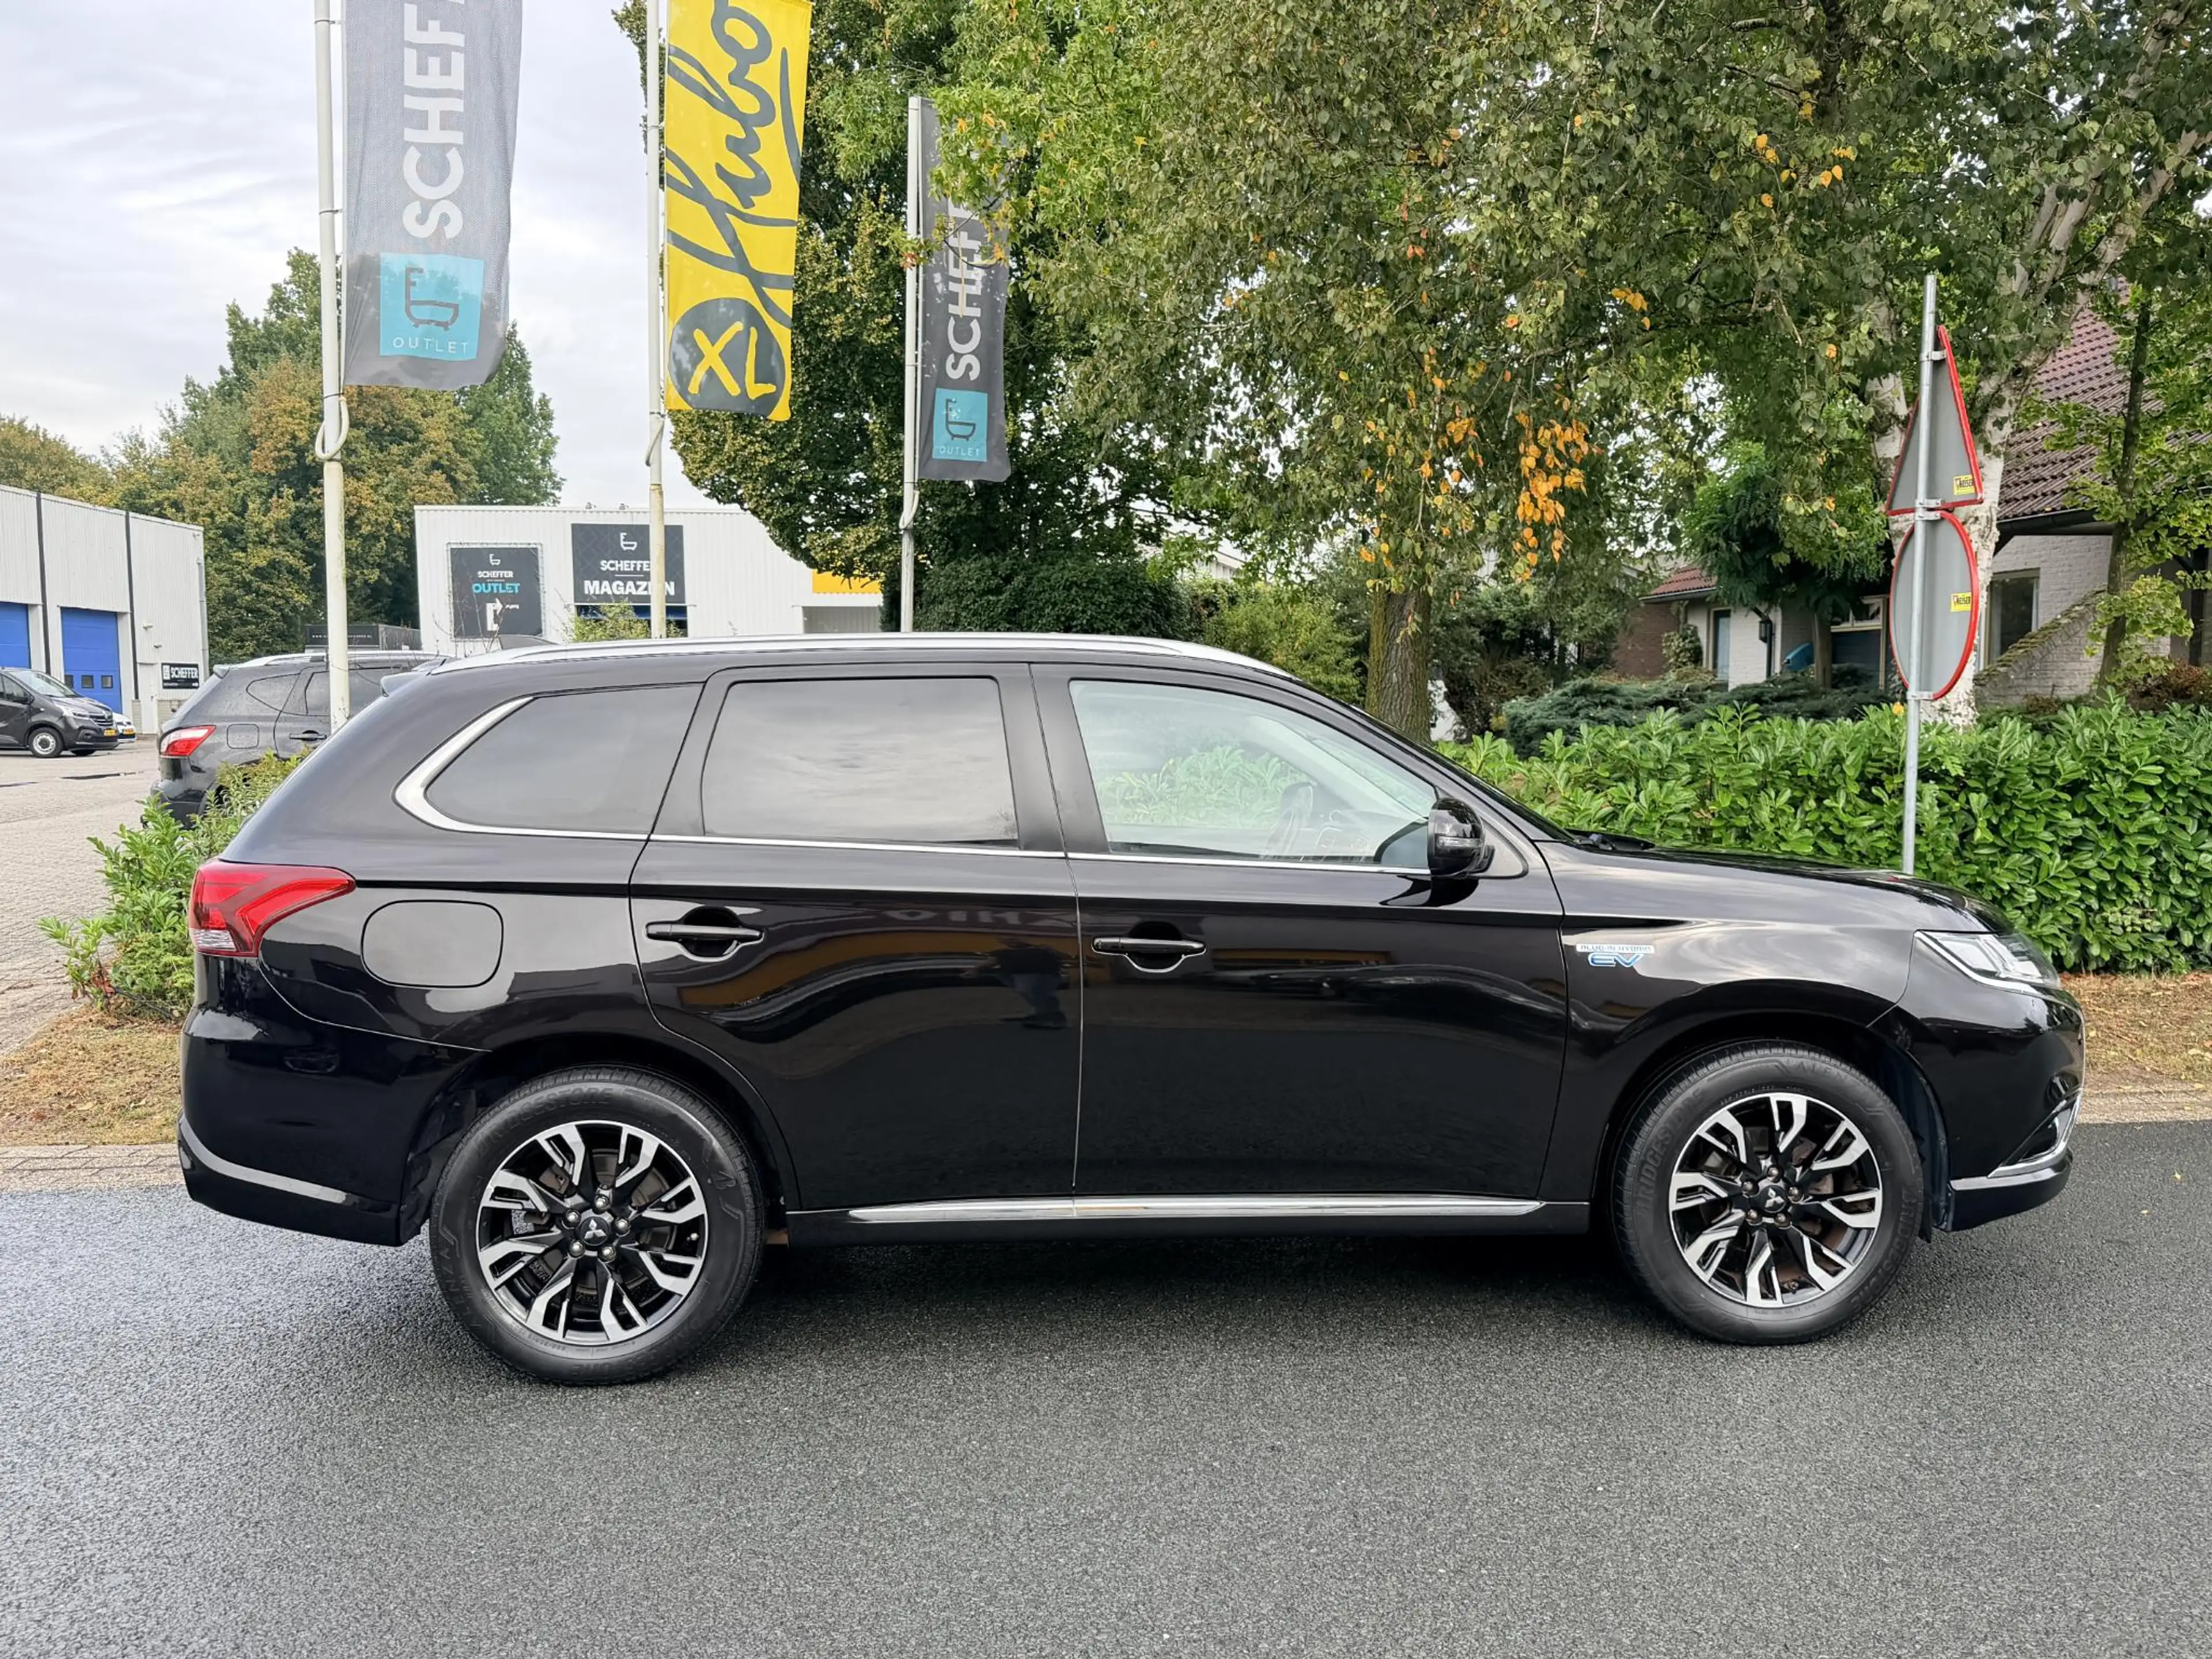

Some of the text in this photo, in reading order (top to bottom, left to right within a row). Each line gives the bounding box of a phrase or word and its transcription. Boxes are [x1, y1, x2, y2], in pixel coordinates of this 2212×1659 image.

[403, 0, 464, 240] SCHEF
[392, 336, 469, 355] OUTLET
[688, 321, 776, 400] XL
[939, 445, 979, 456] OUTLET
[600, 559, 650, 571] SCHEFFE
[477, 570, 514, 578] SCHEFFER
[472, 582, 521, 594] OUTLET
[584, 580, 675, 596] MAGAZIN
[1588, 952, 1643, 968] EV
